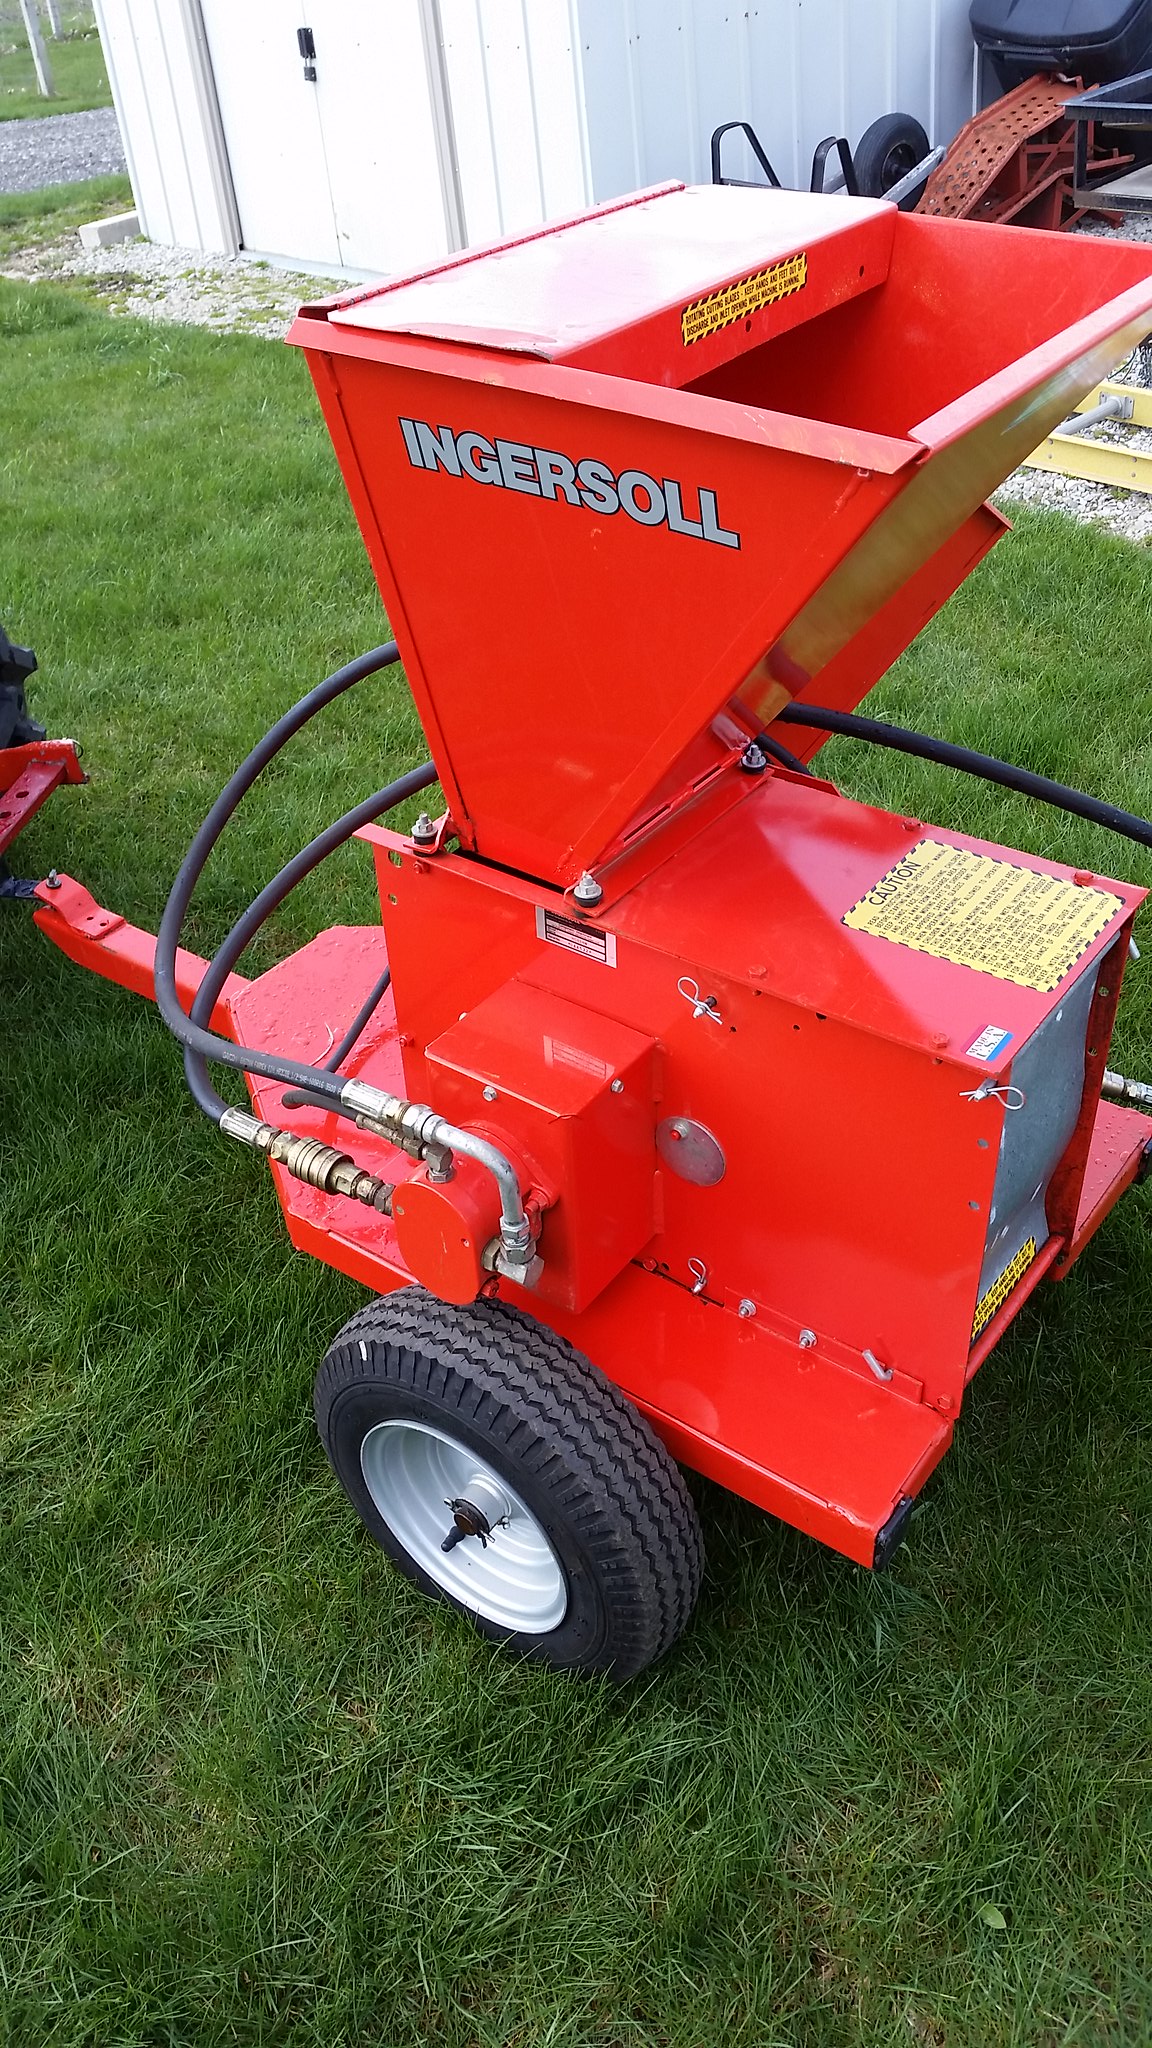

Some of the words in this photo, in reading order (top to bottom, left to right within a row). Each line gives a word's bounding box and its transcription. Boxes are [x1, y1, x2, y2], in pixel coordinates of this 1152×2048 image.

[685, 308, 704, 325] ROTATING
[706, 299, 723, 315] CUTTING
[724, 291, 739, 306] BLADES
[744, 284, 754, 297] KEEP
[755, 277, 768, 291] HANDS
[778, 268, 787, 280] FEET
[686, 318, 708, 336] DISCHARGE
[710, 313, 718, 324] AND
[719, 307, 730, 320] INLET
[731, 299, 747, 314] OPENING
[748, 293, 759, 306] WHILE
[761, 284, 777, 299] MACHINE
[398, 416, 741, 551] INGERSOLL
[868, 860, 922, 906] CAUTION
